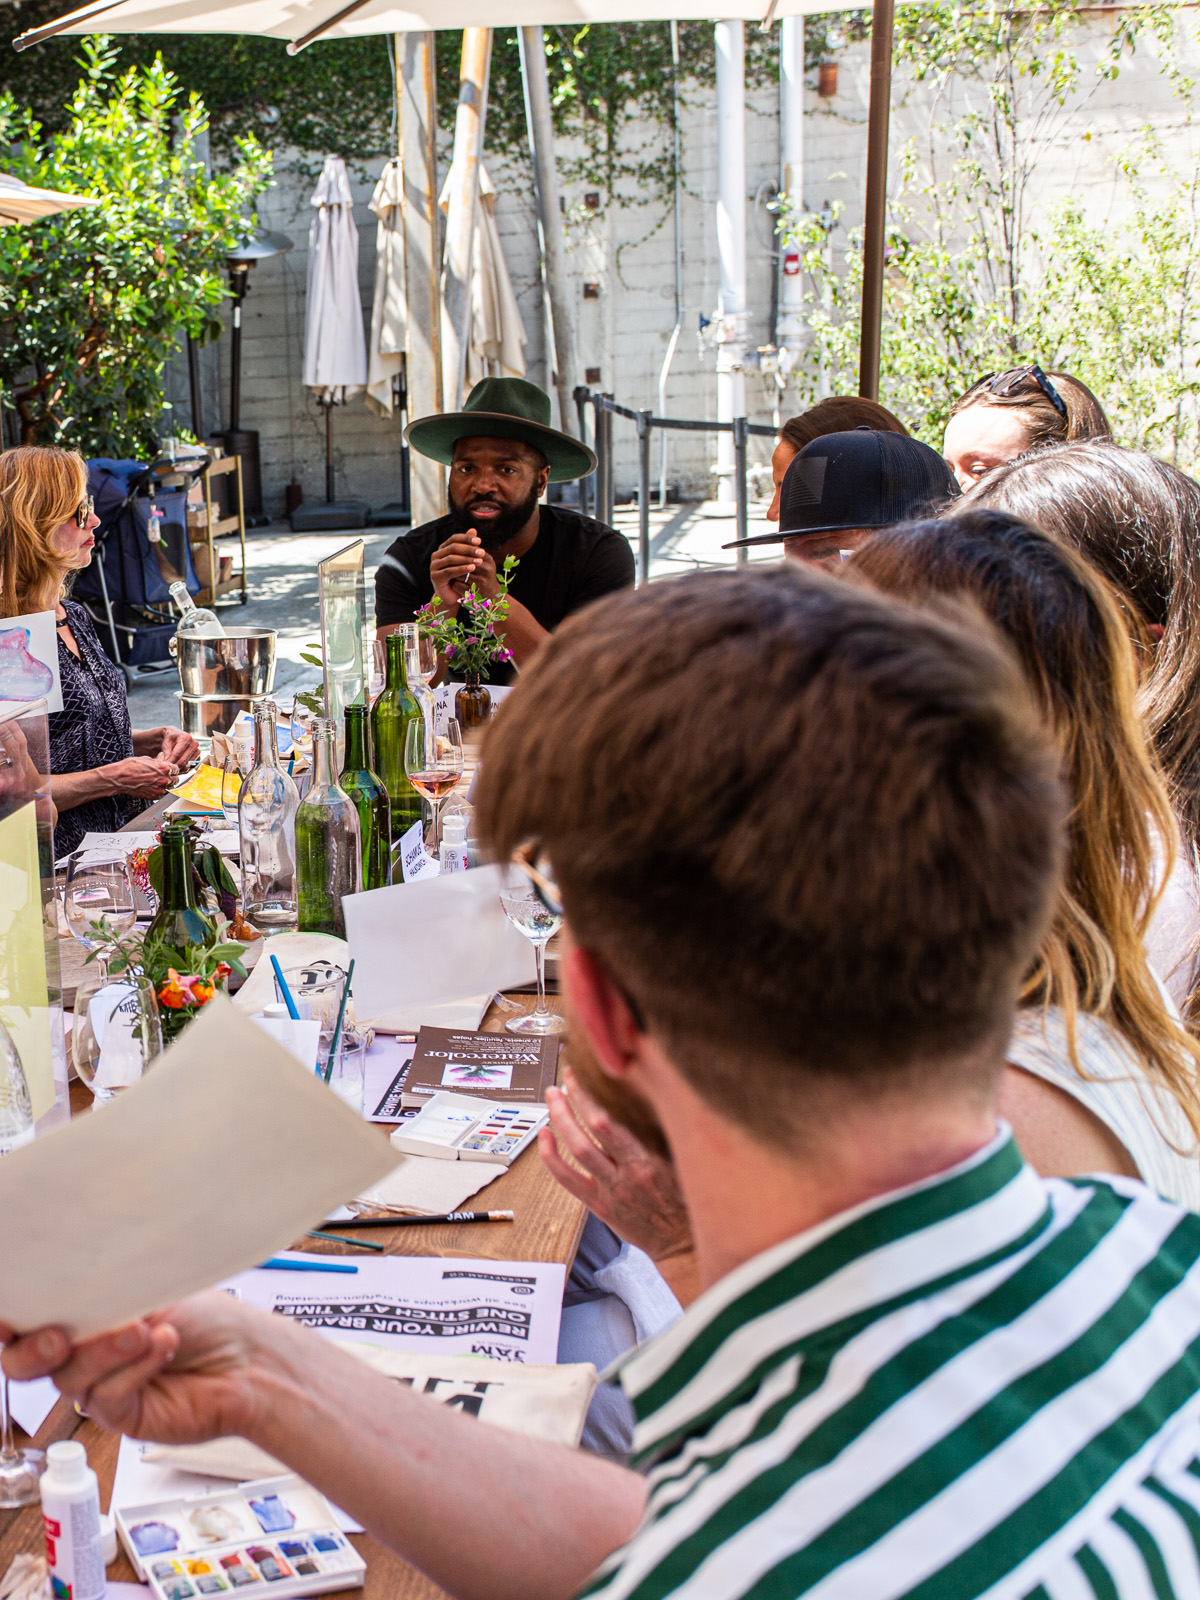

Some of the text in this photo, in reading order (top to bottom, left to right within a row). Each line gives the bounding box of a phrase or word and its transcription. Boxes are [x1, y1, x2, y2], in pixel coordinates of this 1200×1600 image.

[424, 1051, 541, 1062] Watercolor
[447, 1211, 474, 1221] JAM
[414, 1298, 481, 1306] workshops
[278, 1304, 526, 1322] ONE STITCH AT A TIME.
[301, 1316, 526, 1338] REWIRE YOUR BRAIN
[471, 1345, 526, 1359] JAM
